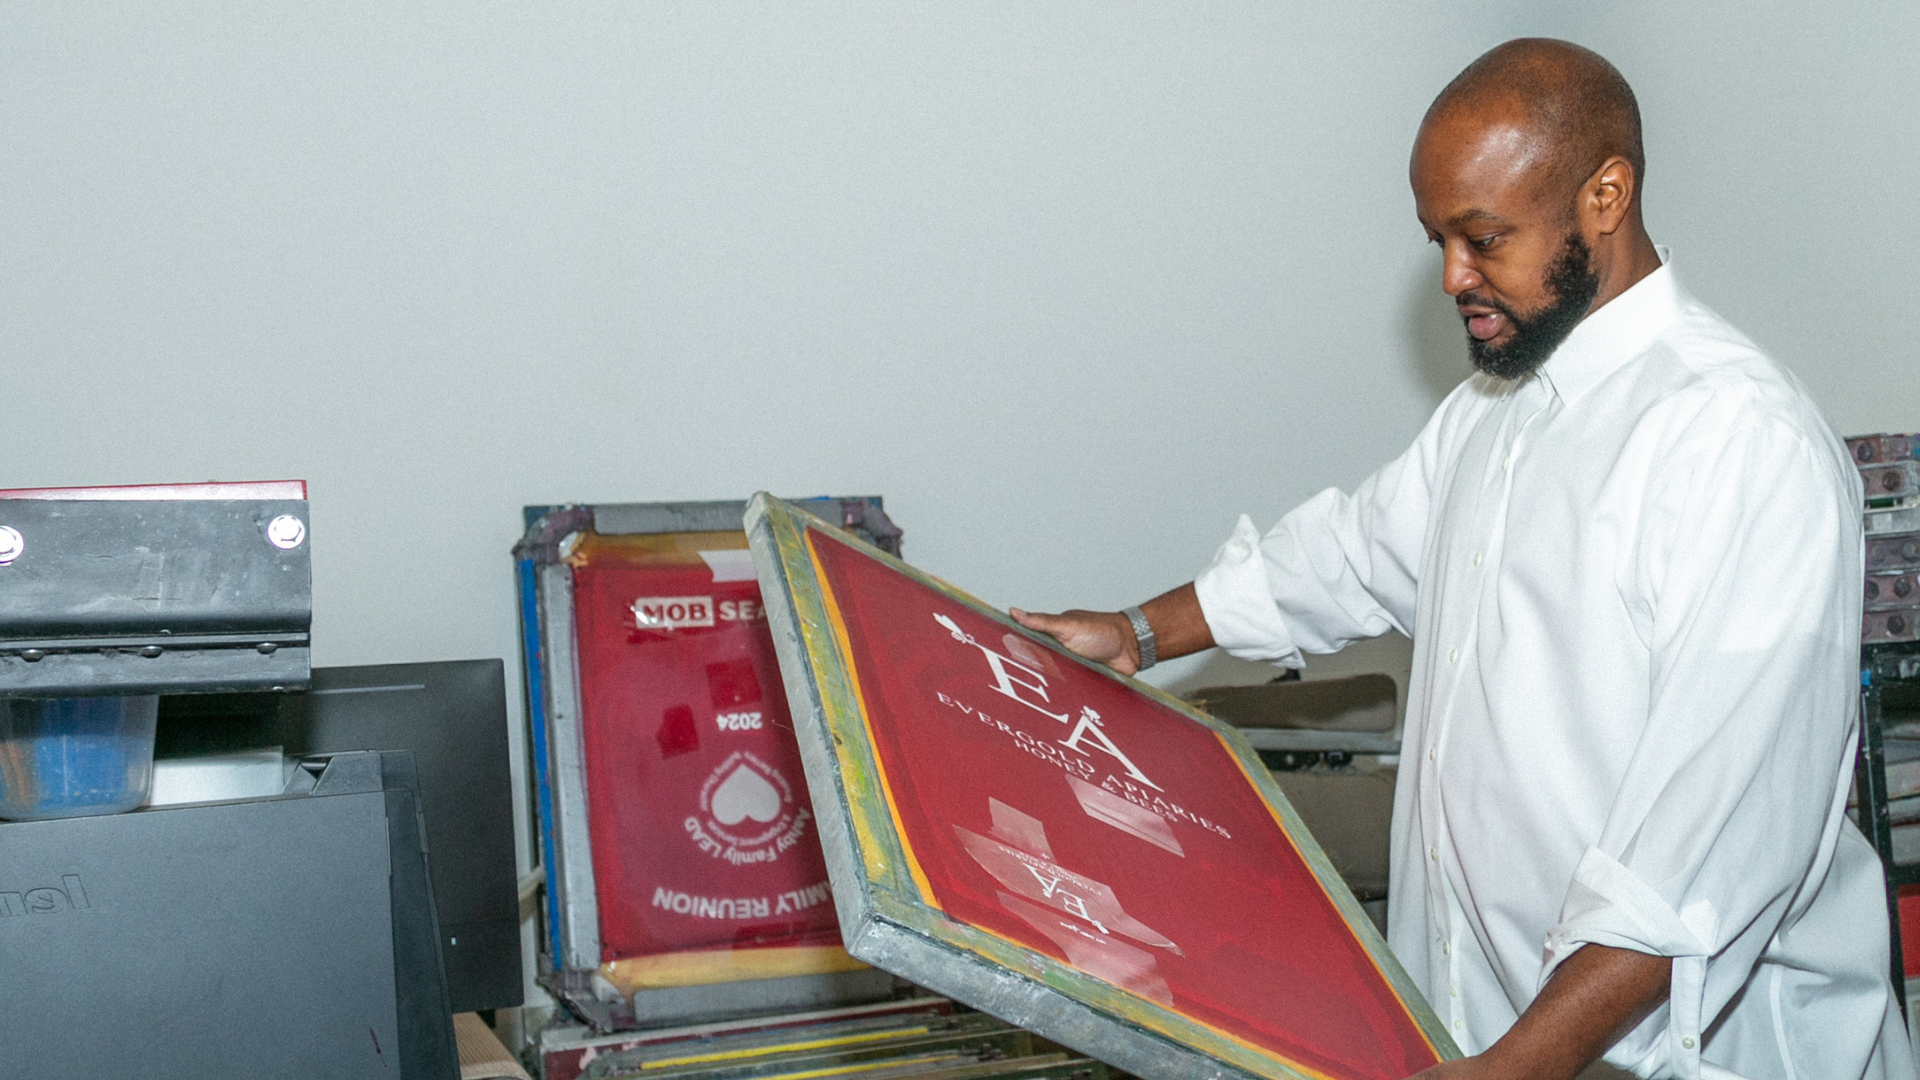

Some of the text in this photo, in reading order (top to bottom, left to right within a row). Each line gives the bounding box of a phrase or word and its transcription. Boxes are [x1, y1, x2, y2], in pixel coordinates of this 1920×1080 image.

[642, 602, 707, 622] MOB
[716, 712, 762, 731] 2024
[937, 692, 1232, 840] EVERGOLD APIARIES
[1014, 739, 1179, 823] HONEY & BEES
[684, 816, 722, 858] LEAD
[723, 846, 777, 867] Family
[652, 886, 770, 920] REUNION
